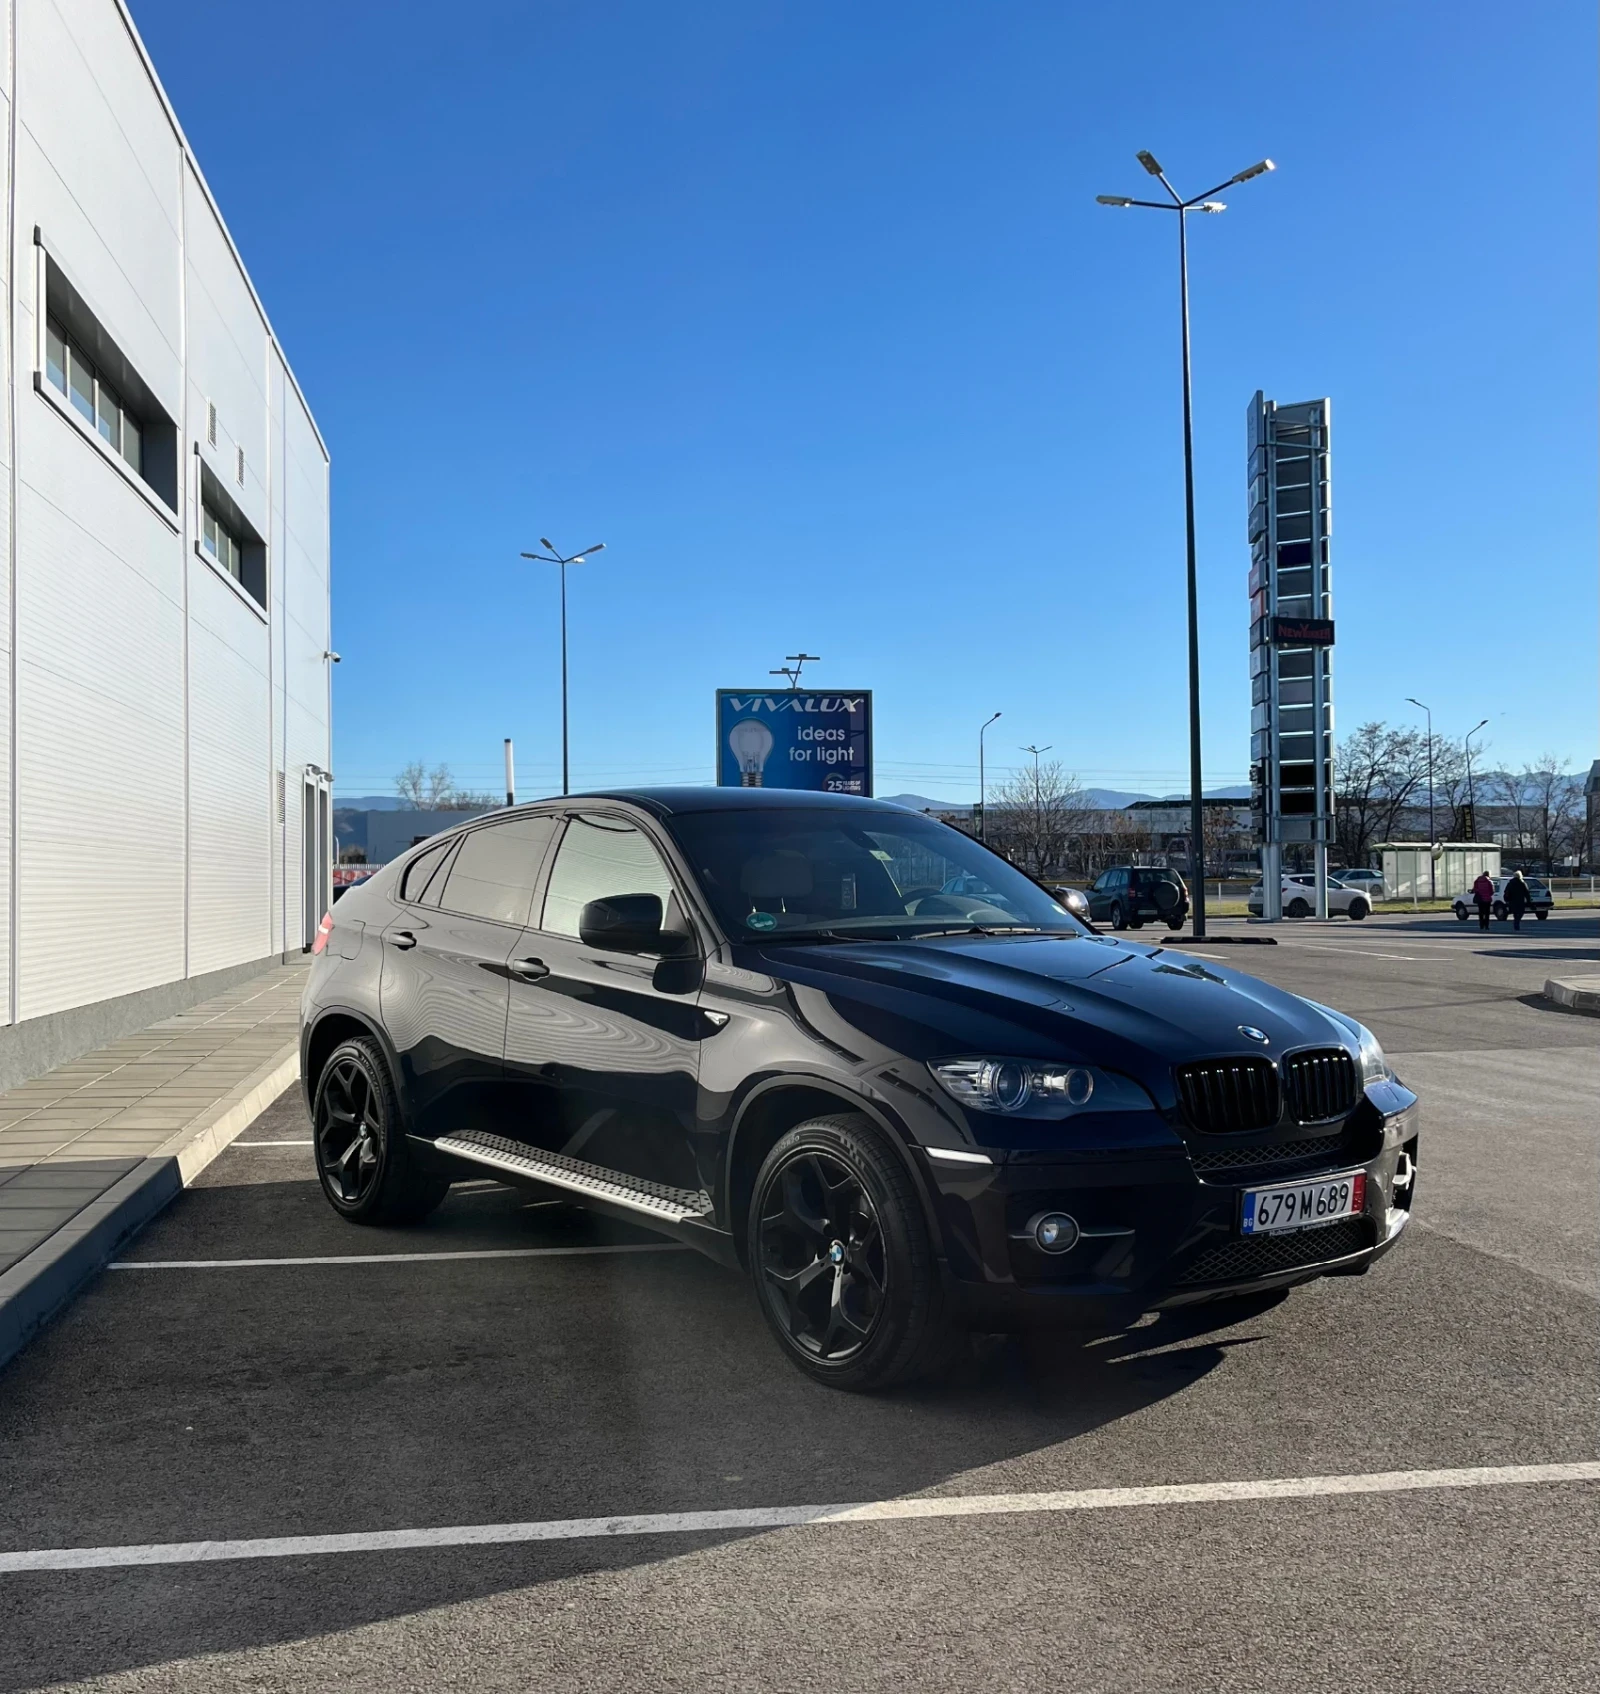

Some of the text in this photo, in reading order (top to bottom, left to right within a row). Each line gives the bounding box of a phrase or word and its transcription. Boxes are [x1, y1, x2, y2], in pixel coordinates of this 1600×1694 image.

[730, 698, 860, 712] VIVALUX
[798, 726, 845, 741] ideas
[789, 747, 855, 765] for light
[827, 781, 843, 791] 25
[1243, 1217, 1253, 1227] BG
